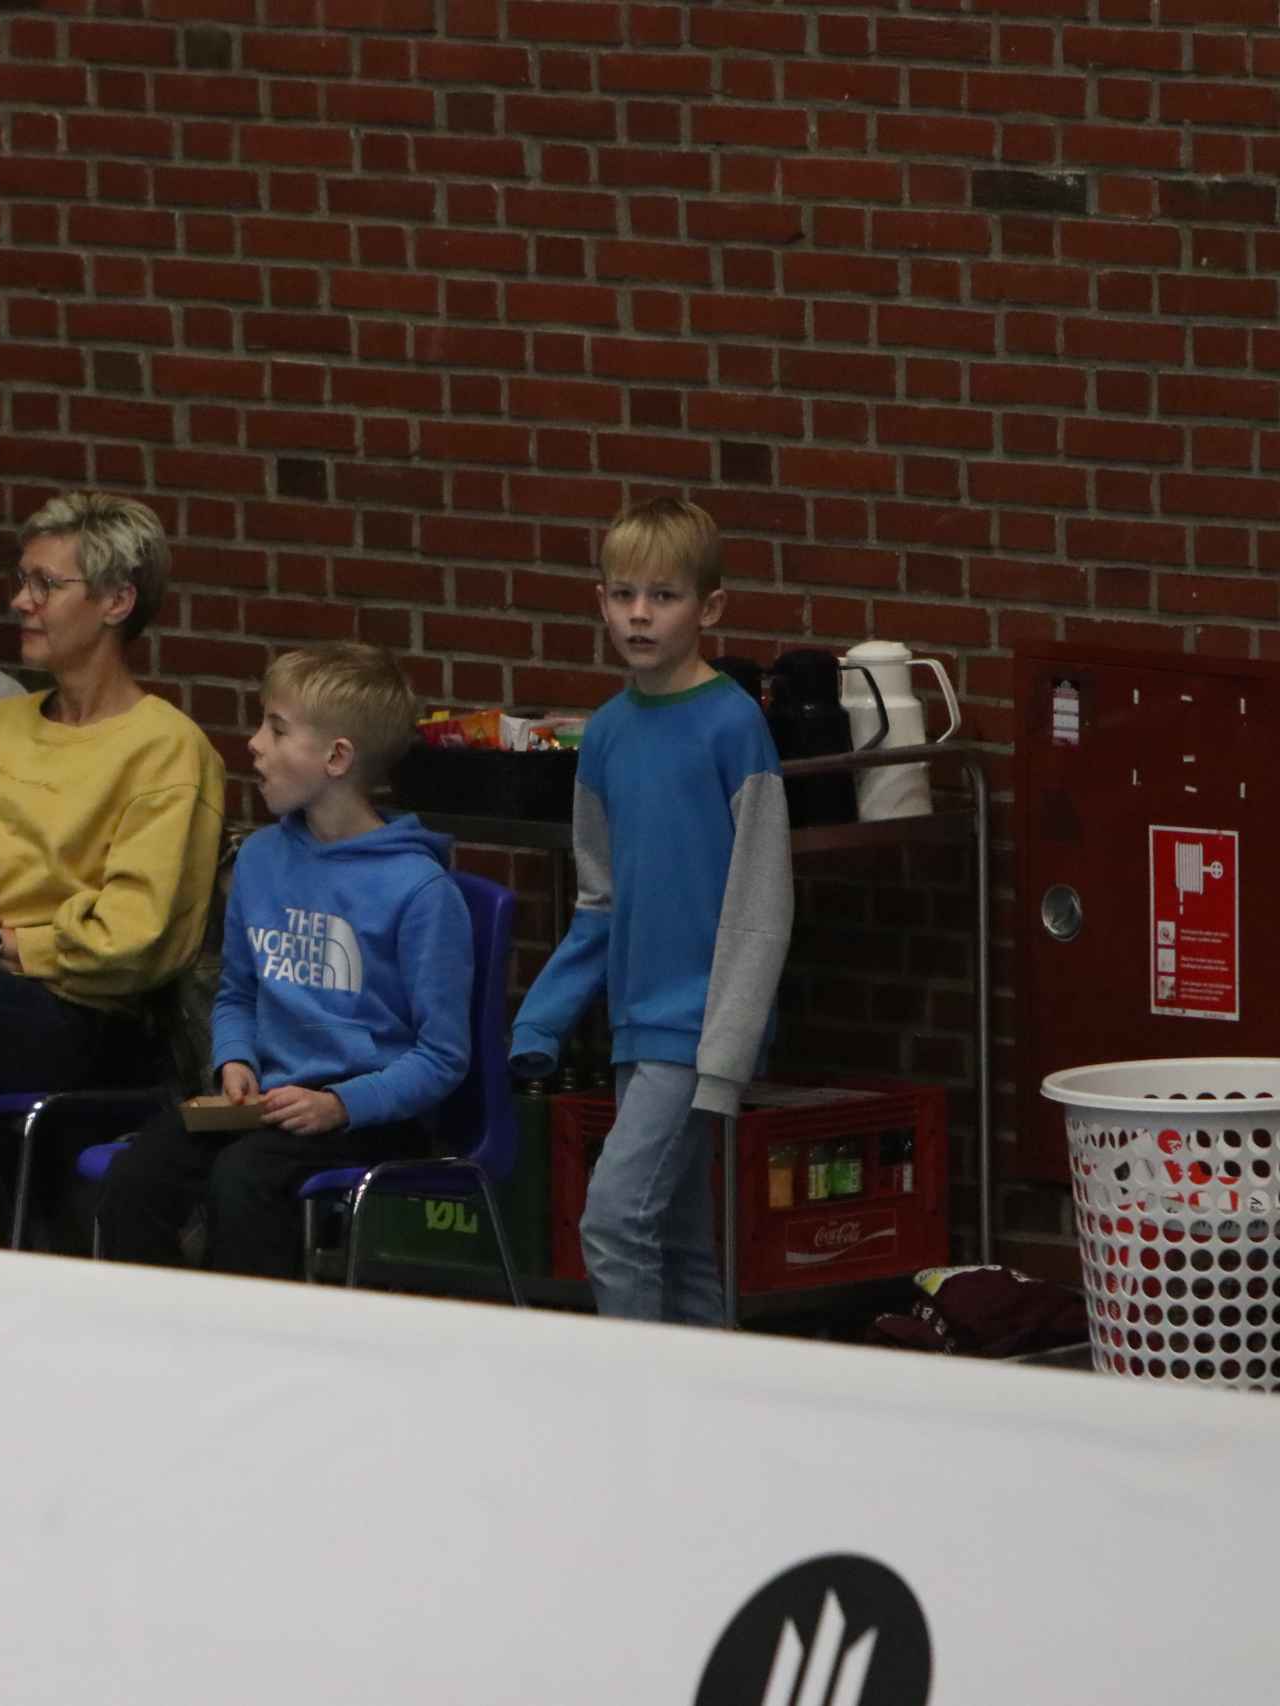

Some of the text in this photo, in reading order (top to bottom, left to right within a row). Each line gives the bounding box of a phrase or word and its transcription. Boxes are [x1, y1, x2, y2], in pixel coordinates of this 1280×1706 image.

[285, 908, 326, 938] THE
[247, 927, 326, 960] NORTH
[263, 956, 322, 987] FACE
[424, 1199, 478, 1234] ØL
